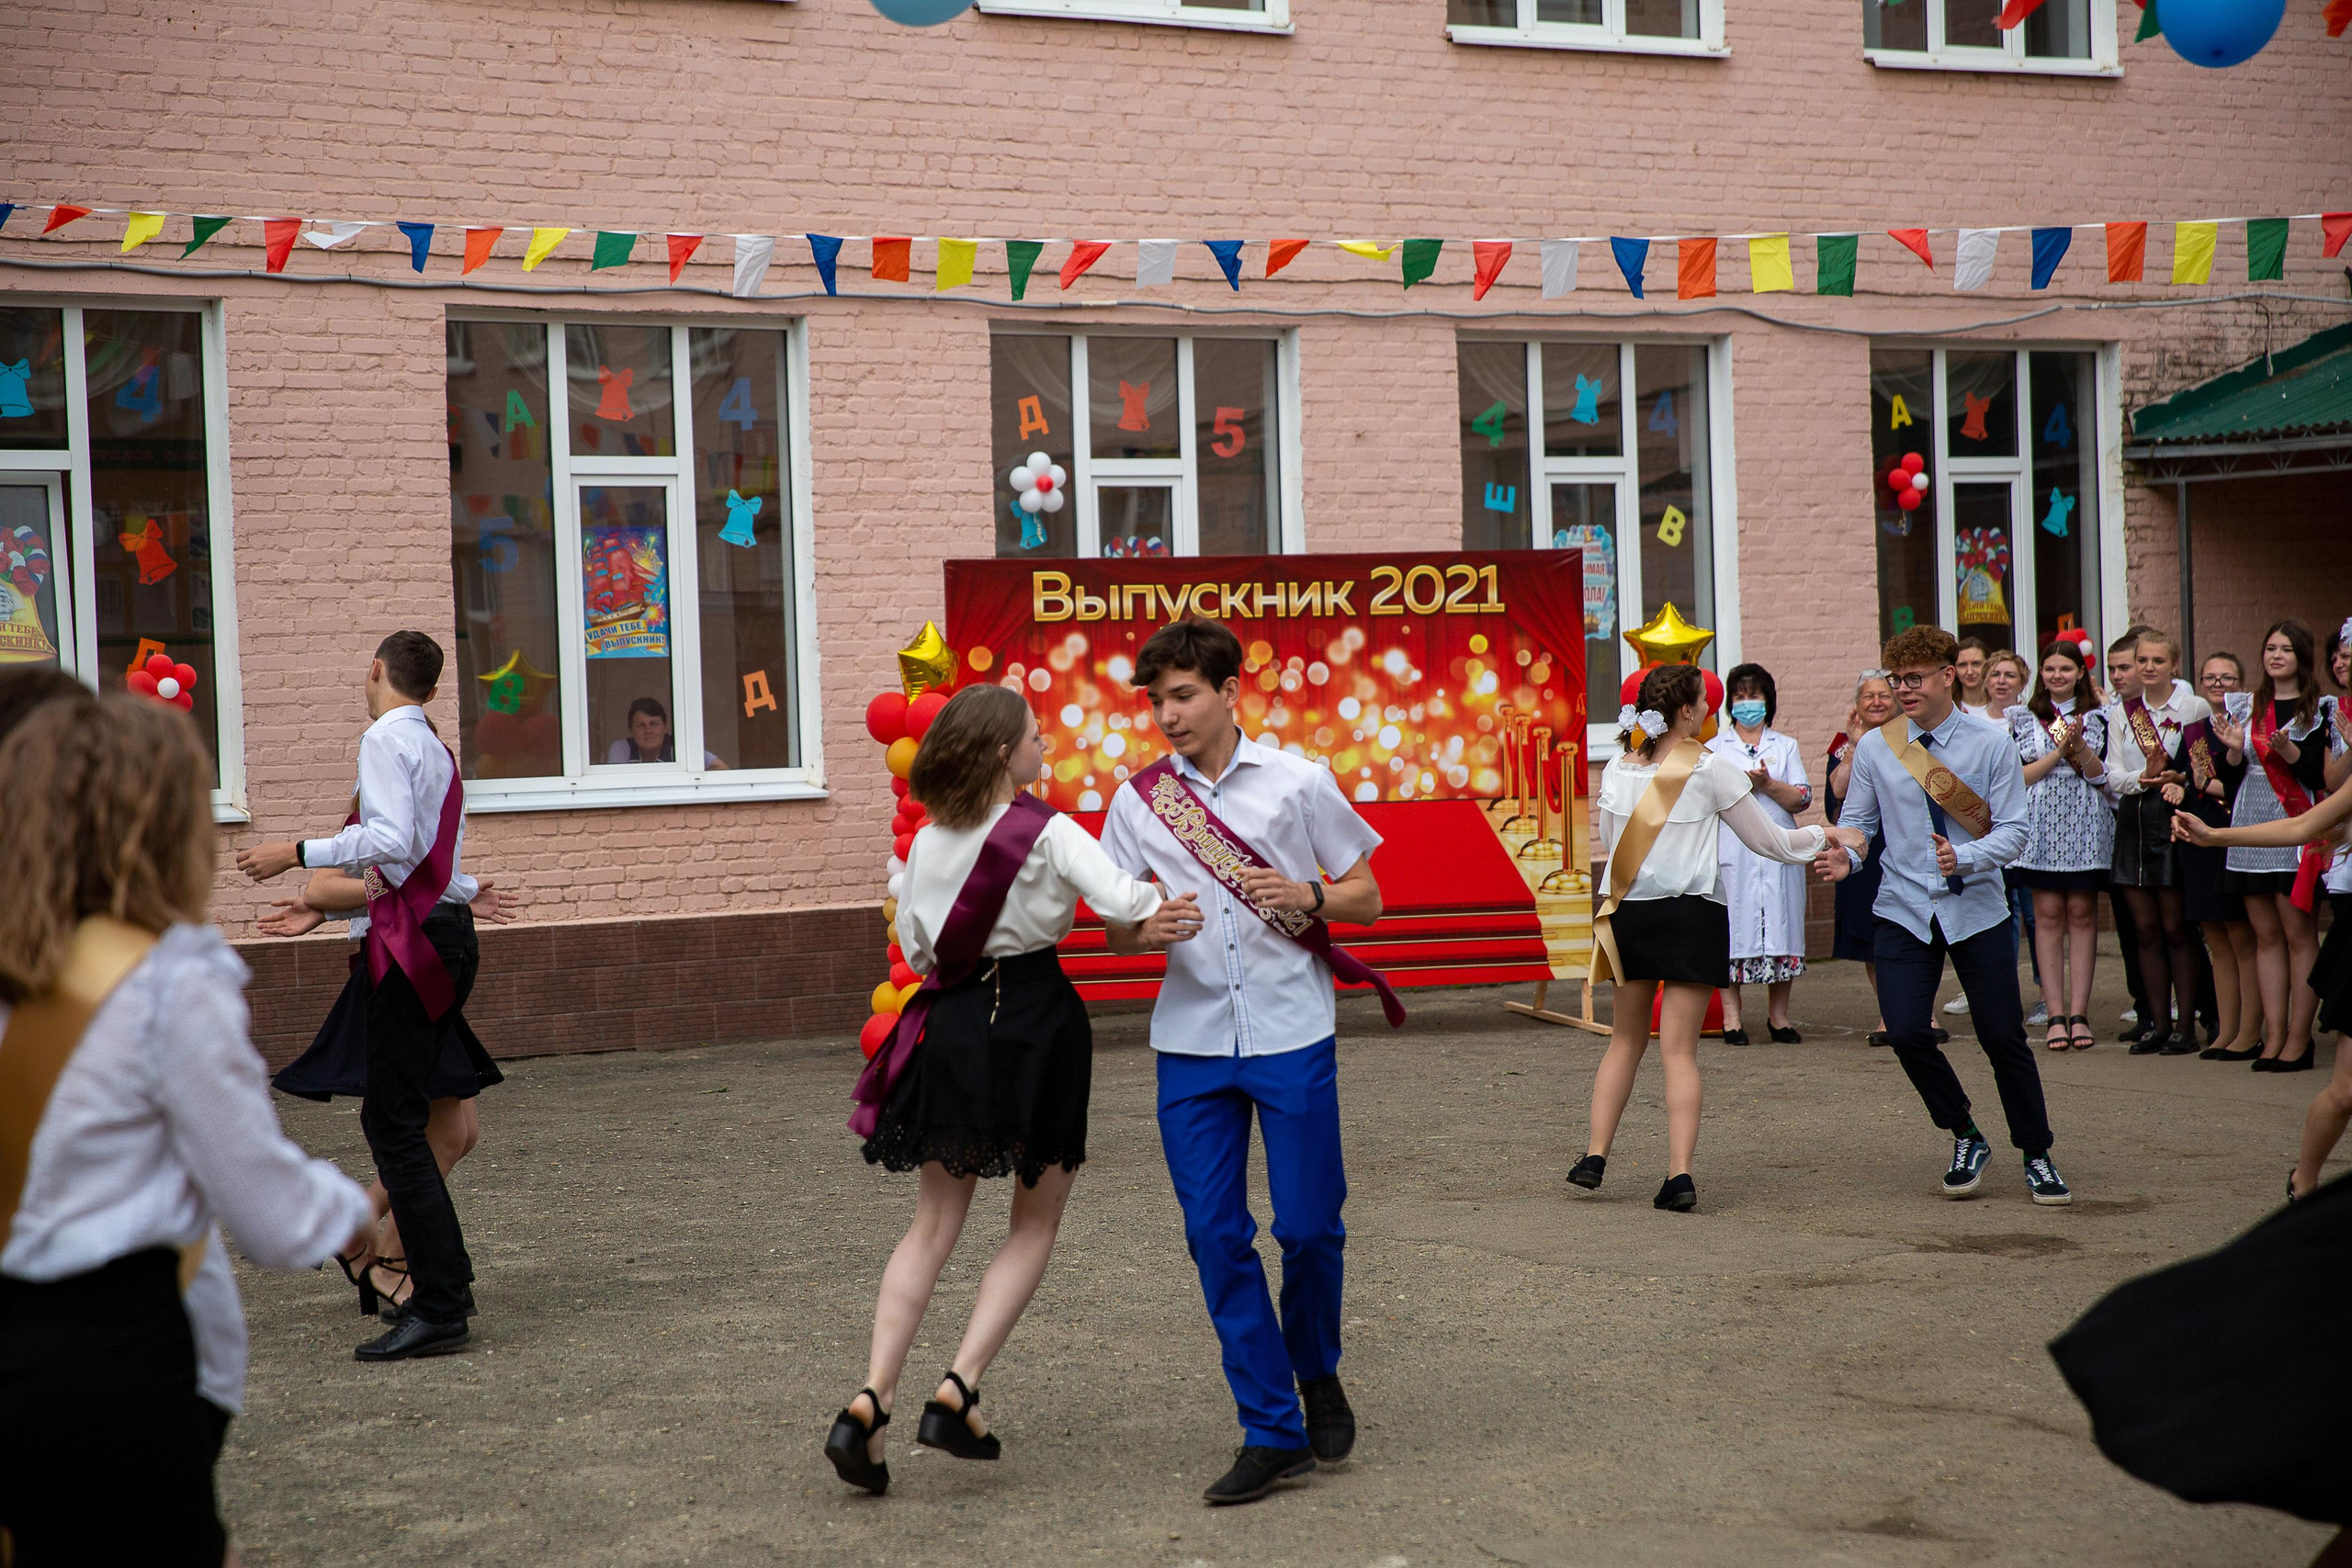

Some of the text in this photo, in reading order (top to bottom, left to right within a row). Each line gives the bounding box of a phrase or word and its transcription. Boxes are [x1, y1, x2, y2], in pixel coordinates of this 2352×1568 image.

[115, 365, 163, 423] 4
[505, 390, 536, 432] А
[718, 377, 758, 431] 4
[1648, 390, 1679, 438] 4
[1891, 394, 1913, 430] А
[1018, 395, 1050, 441] Д
[1211, 406, 1246, 458] 5
[1471, 400, 1507, 448] 4
[2044, 402, 2072, 448] 4
[479, 515, 518, 573] 5
[1657, 504, 1687, 547] В
[1585, 563, 1605, 576] ИМАЯ
[1033, 564, 1506, 630] Выпускник 2021
[1584, 587, 1607, 603] ОЛА!
[586, 625, 618, 640] УДАЧИ
[605, 635, 665, 649] ВЫПУСКНИК!
[487, 668, 525, 715] В
[742, 670, 777, 717] Д
